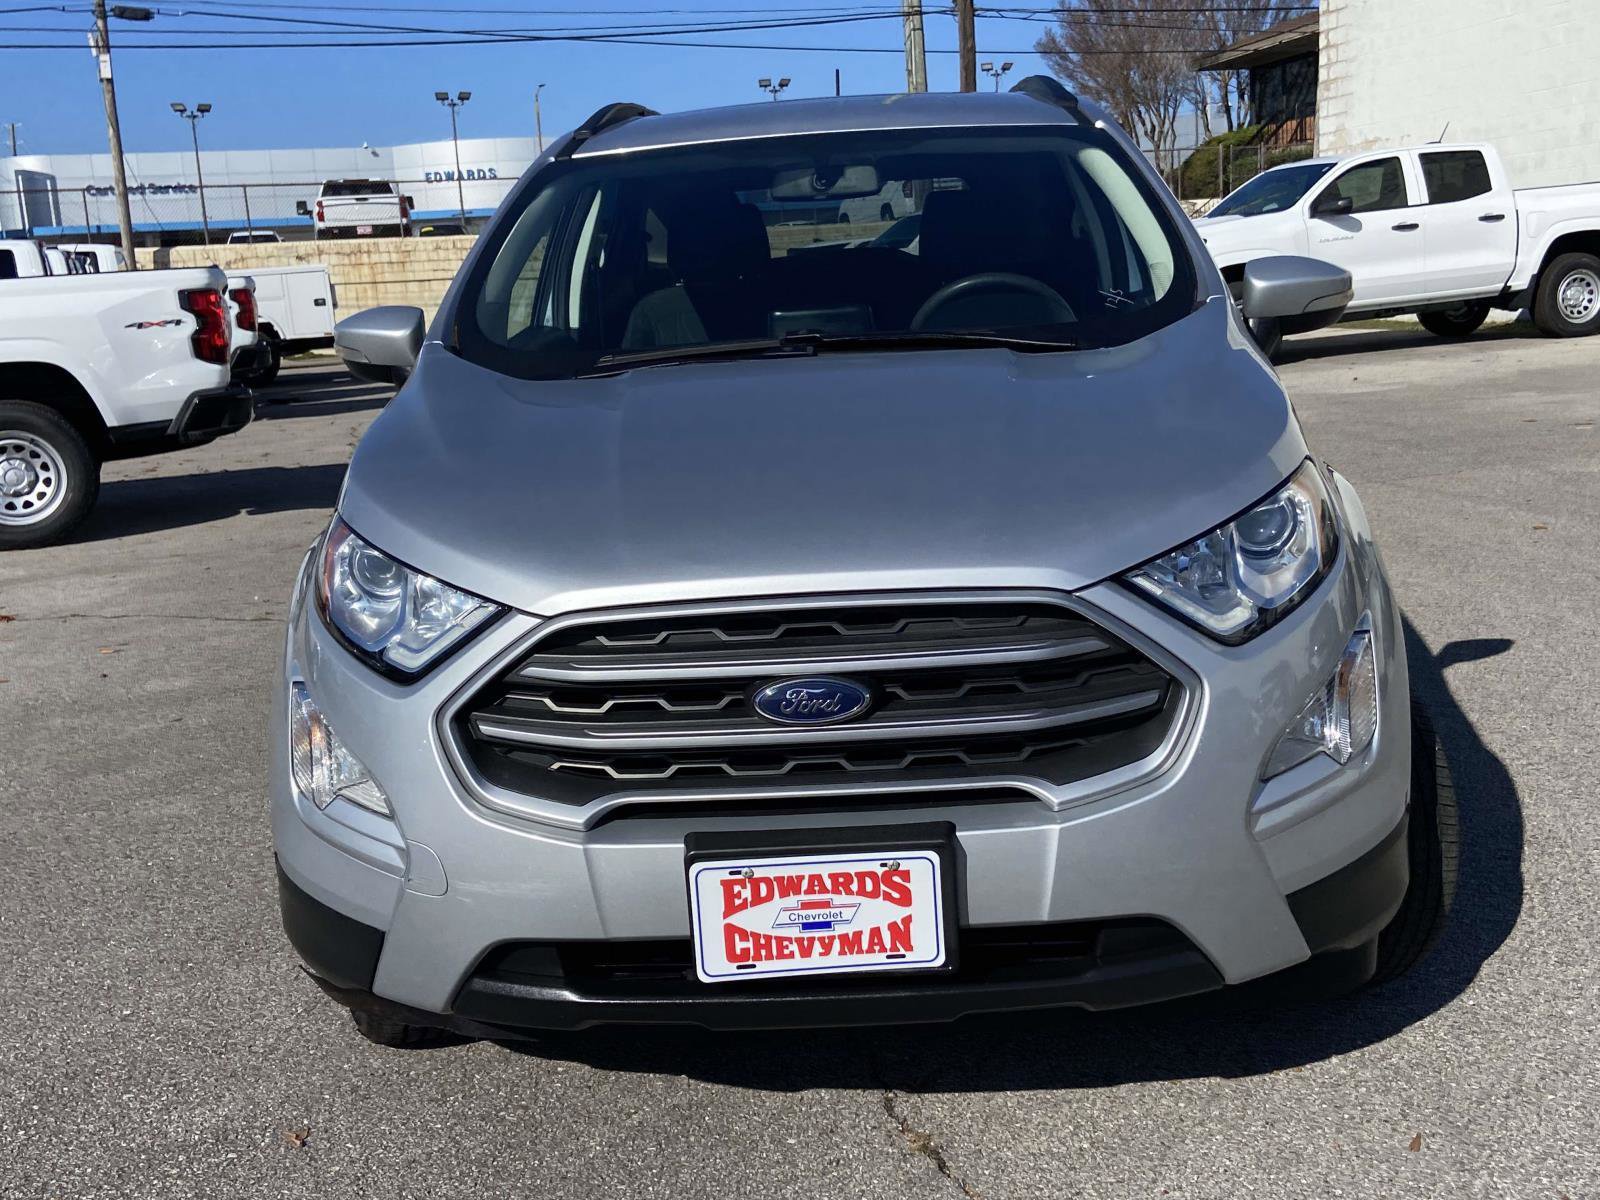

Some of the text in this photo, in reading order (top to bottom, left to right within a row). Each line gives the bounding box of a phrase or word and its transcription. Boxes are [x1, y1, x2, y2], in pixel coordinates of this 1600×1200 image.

[425, 168, 497, 183] EDWARDS
[86, 184, 146, 196] Certed
[780, 688, 842, 715] Ford
[720, 869, 912, 920] EDWARDS
[788, 910, 844, 922] Chevrolet
[723, 914, 914, 963] CHEVYMAN
